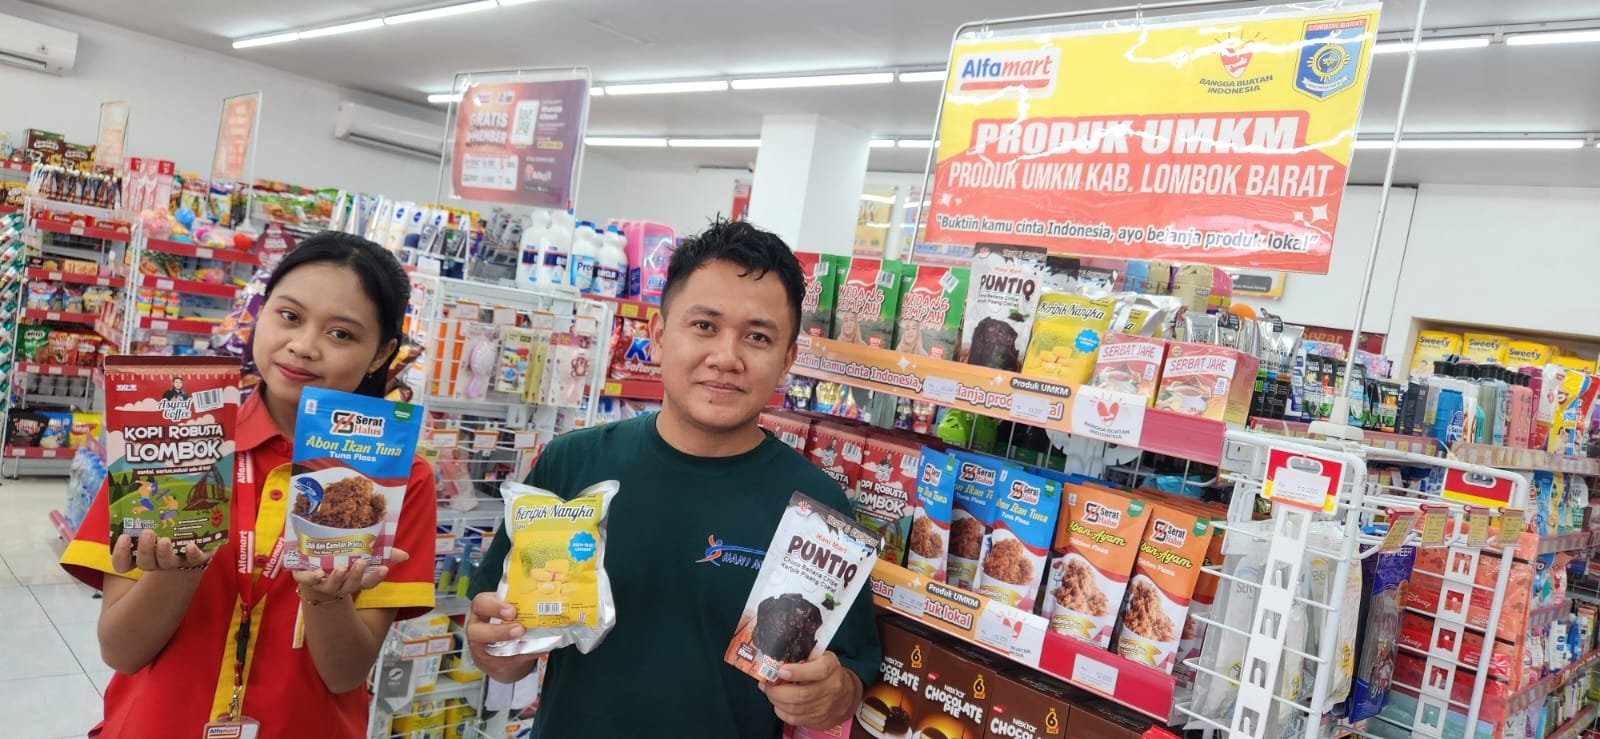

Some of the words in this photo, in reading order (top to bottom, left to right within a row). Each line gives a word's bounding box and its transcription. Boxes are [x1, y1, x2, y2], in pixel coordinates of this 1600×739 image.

[961, 55, 1053, 81] Alfamart
[1199, 77, 1236, 87] BANGGA
[1238, 74, 1273, 86] BUATAN
[1207, 84, 1260, 95] INDONESIA
[973, 120, 1134, 155] PRODUK
[1142, 116, 1300, 154] UMKM
[948, 163, 1016, 188] PRODUK
[1022, 164, 1081, 190] UMKM
[1083, 165, 1133, 191] KAB.
[1141, 164, 1241, 195] LOMBOK
[1245, 165, 1333, 197] BARAT
[981, 218, 1014, 233] kamu
[1015, 220, 1044, 235] cinta
[1047, 222, 1115, 241] Indonesia,
[1118, 227, 1144, 243] ayo
[1206, 231, 1262, 250] produk
[980, 274, 1035, 301] PUNTIQ
[1069, 303, 1104, 321] Nangka
[1419, 335, 1450, 347] Sweety
[1468, 338, 1500, 350] Sweety
[1103, 344, 1137, 359] SERBAT
[1138, 345, 1156, 359] JAHE
[1508, 347, 1541, 360] Sweety
[820, 357, 846, 374] kamu
[846, 363, 870, 379] cinta
[870, 367, 922, 391] Indonesia,
[1170, 358, 1205, 372] SERBAT
[1206, 359, 1227, 371] JAHE
[1012, 378, 1039, 391] Produk
[1040, 384, 1070, 396] UMKM
[163, 409, 191, 421] Coffee
[355, 415, 383, 428] Serat
[125, 426, 163, 443] KOPI
[168, 424, 224, 440] ROBUSTA
[354, 425, 381, 437] Halus
[126, 439, 220, 463] LOMBOK
[306, 435, 340, 451] Abon
[342, 439, 372, 454] Ikan
[376, 442, 403, 457] Tuna
[329, 451, 351, 461] Tuna
[353, 454, 376, 462] Floss
[976, 468, 995, 478] Serat
[861, 479, 874, 489] OPI
[875, 480, 908, 502] ROBUSTA
[966, 484, 985, 496] Ikan
[1024, 486, 1039, 497] Serat
[859, 491, 905, 518] OMBOK
[1010, 502, 1027, 516] Ikan
[1029, 506, 1049, 523] Tuna
[515, 505, 548, 522] Keripik
[550, 504, 594, 524] Nangka
[1098, 516, 1117, 528] Halus
[1100, 507, 1120, 521] Serat
[1089, 529, 1126, 548] Ayam
[1165, 535, 1183, 547] Halus
[1167, 526, 1186, 540] Serat
[238, 530, 248, 574] Alfamart
[816, 532, 831, 546] Hani
[831, 539, 848, 555] Mart
[787, 535, 858, 589] PUNTIQ
[1156, 549, 1192, 569] Ayam
[800, 570, 819, 587] Pisang
[929, 583, 953, 598] Produk
[953, 592, 979, 607] UMKM
[944, 604, 972, 627] lokal
[912, 646, 922, 663] 6
[880, 663, 920, 692] OCOLATE
[883, 672, 899, 688] PIE
[973, 677, 985, 694] 6
[925, 684, 983, 725] CHOCOLATE
[943, 701, 960, 719] PIE
[1046, 710, 1058, 729] 6
